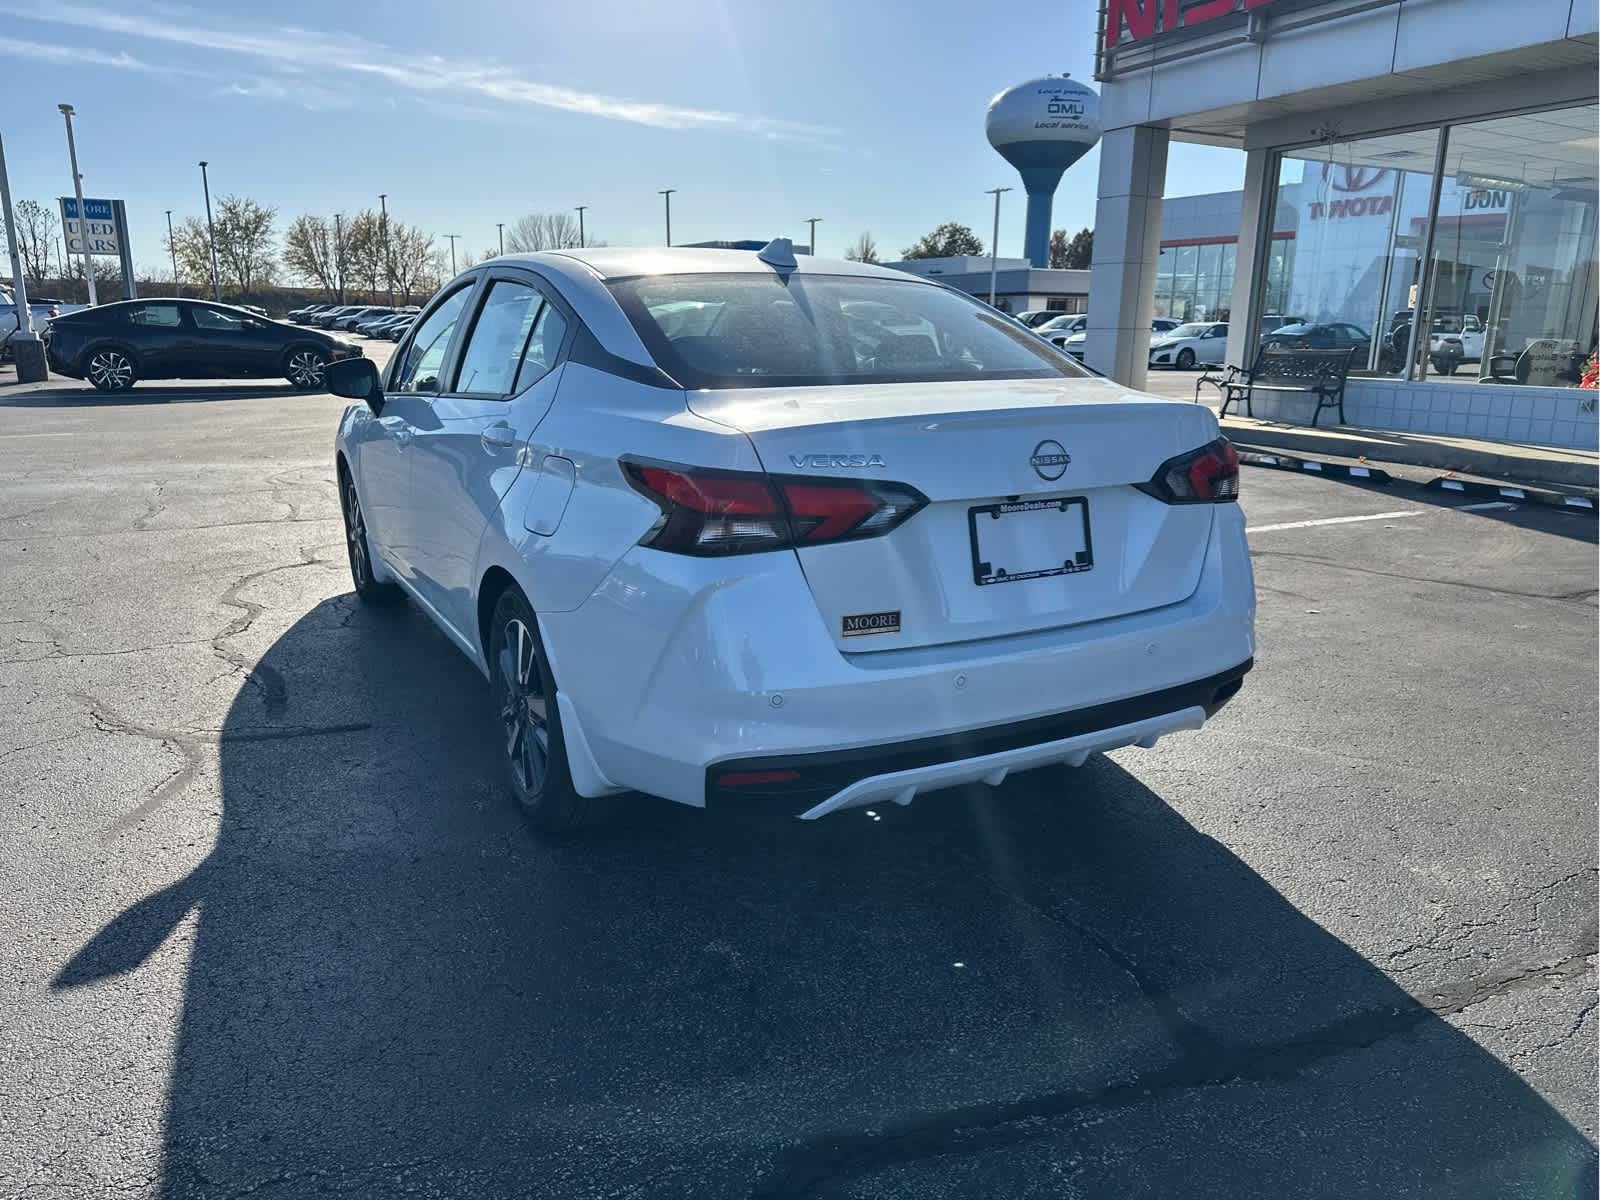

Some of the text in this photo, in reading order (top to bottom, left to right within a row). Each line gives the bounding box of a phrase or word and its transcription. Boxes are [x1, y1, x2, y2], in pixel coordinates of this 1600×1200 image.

[1106, 0, 1274, 48] NI
[1047, 103, 1085, 114] OMU
[1034, 120, 1060, 129] Local
[66, 203, 110, 213] MORE
[788, 454, 887, 468] VERSA
[1031, 455, 1071, 466] NISSAN
[1000, 500, 1062, 513] MooreDeals.com
[847, 614, 897, 631] MOORE
